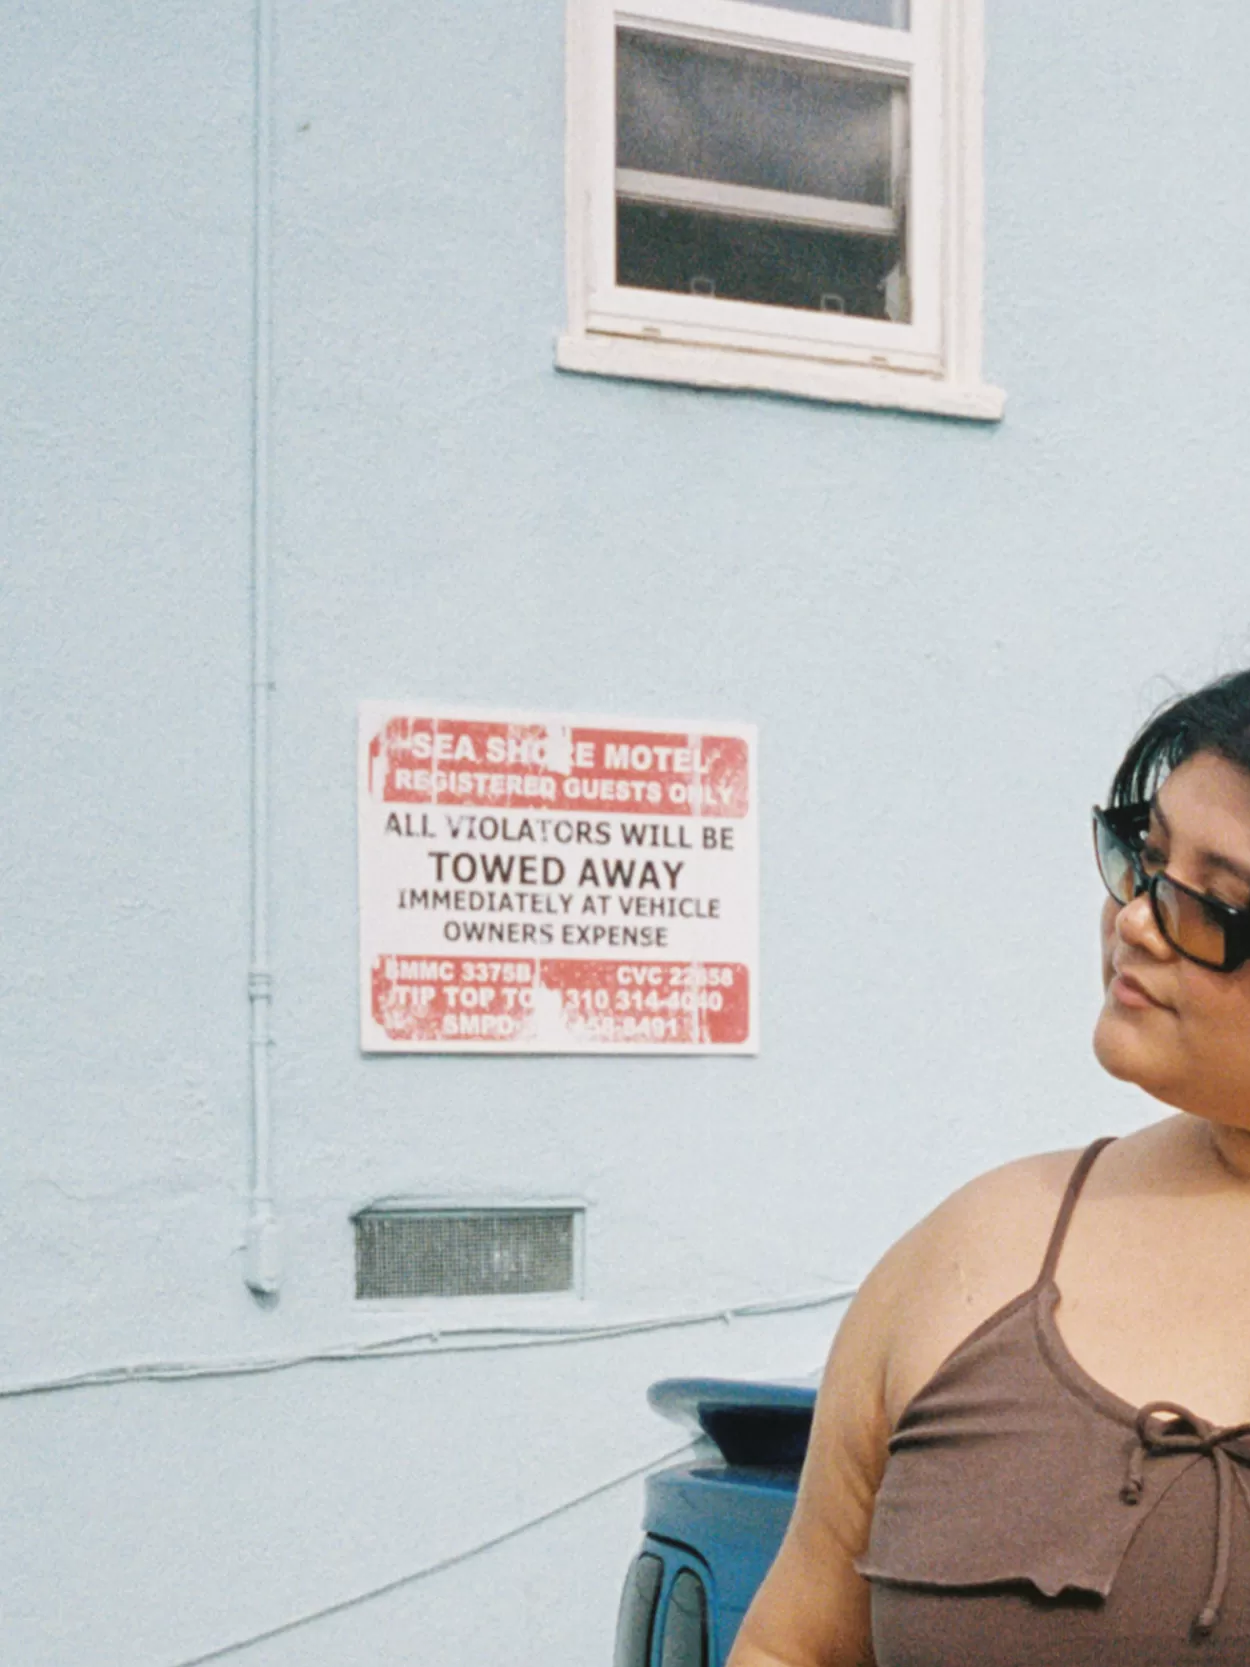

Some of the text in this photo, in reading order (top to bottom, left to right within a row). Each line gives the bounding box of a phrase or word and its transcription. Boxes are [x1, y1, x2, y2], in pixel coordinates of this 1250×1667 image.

[412, 732, 476, 761] SEA
[604, 743, 709, 773] MOTEL
[396, 768, 556, 799] REGISTERED
[563, 778, 662, 802] GUESTS
[384, 812, 734, 850] ALL VIOLATORS WILL BE
[428, 851, 684, 890] TOWED AWAY
[397, 888, 720, 919] IMMEDIATELY AT VEHICLE
[443, 921, 668, 947] OWNERS EXPENSE
[462, 962, 532, 983] 3375B
[617, 965, 662, 986] CVC
[393, 986, 435, 1005] TIP
[442, 986, 495, 1008] TOP
[566, 989, 609, 1009] 310
